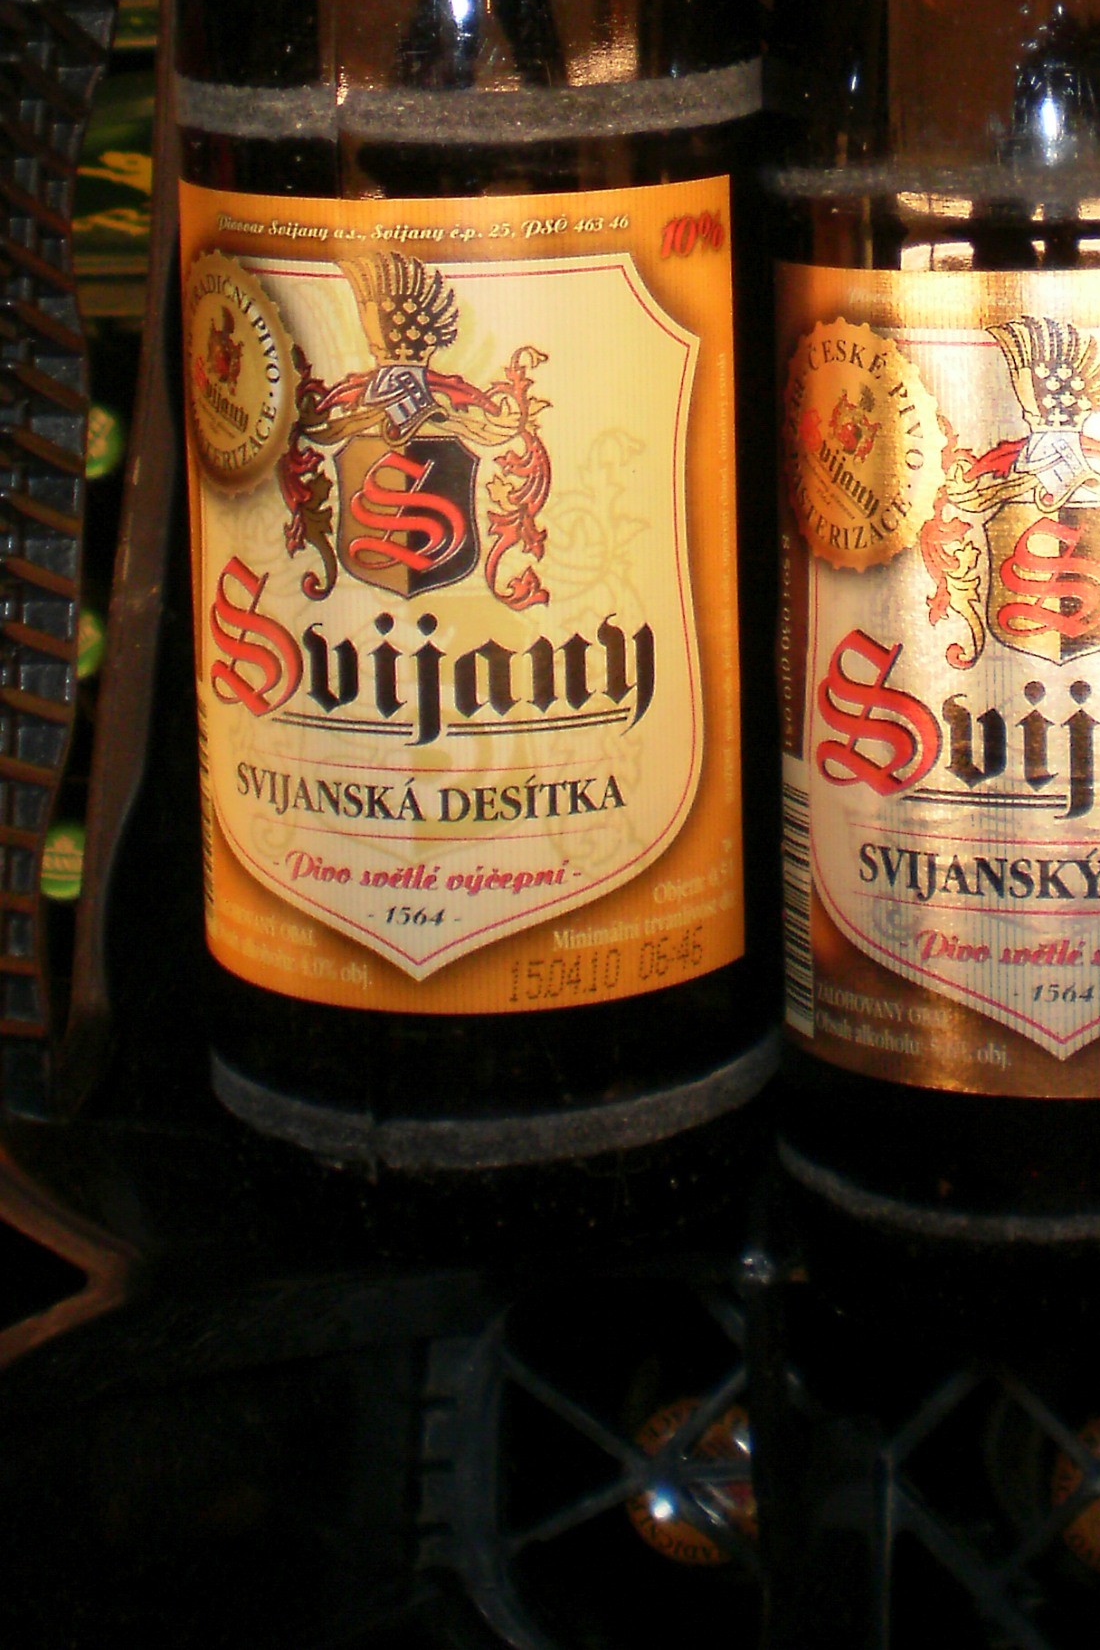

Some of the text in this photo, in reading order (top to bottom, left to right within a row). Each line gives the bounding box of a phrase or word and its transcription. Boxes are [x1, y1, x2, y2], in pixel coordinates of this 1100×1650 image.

[216, 212, 265, 234] Pivovar
[267, 219, 329, 242] Svijany
[370, 223, 445, 244] Svijany
[487, 222, 516, 239] 25,
[520, 212, 569, 240] PSČ
[572, 213, 604, 234] 463
[608, 213, 630, 230] 46
[659, 209, 727, 261] 10%
[250, 314, 282, 386] PIVO
[806, 338, 926, 472] ČESKÉ PIVO
[209, 554, 658, 747] Svijany
[235, 760, 628, 825] SVIJANSKÁ DESÍTKA
[285, 850, 571, 899] Pivo světlé výčepní
[383, 904, 447, 928] 1564
[912, 928, 994, 968] Pivo
[998, 935, 1086, 968] světlé
[1031, 983, 1097, 1005] 1564
